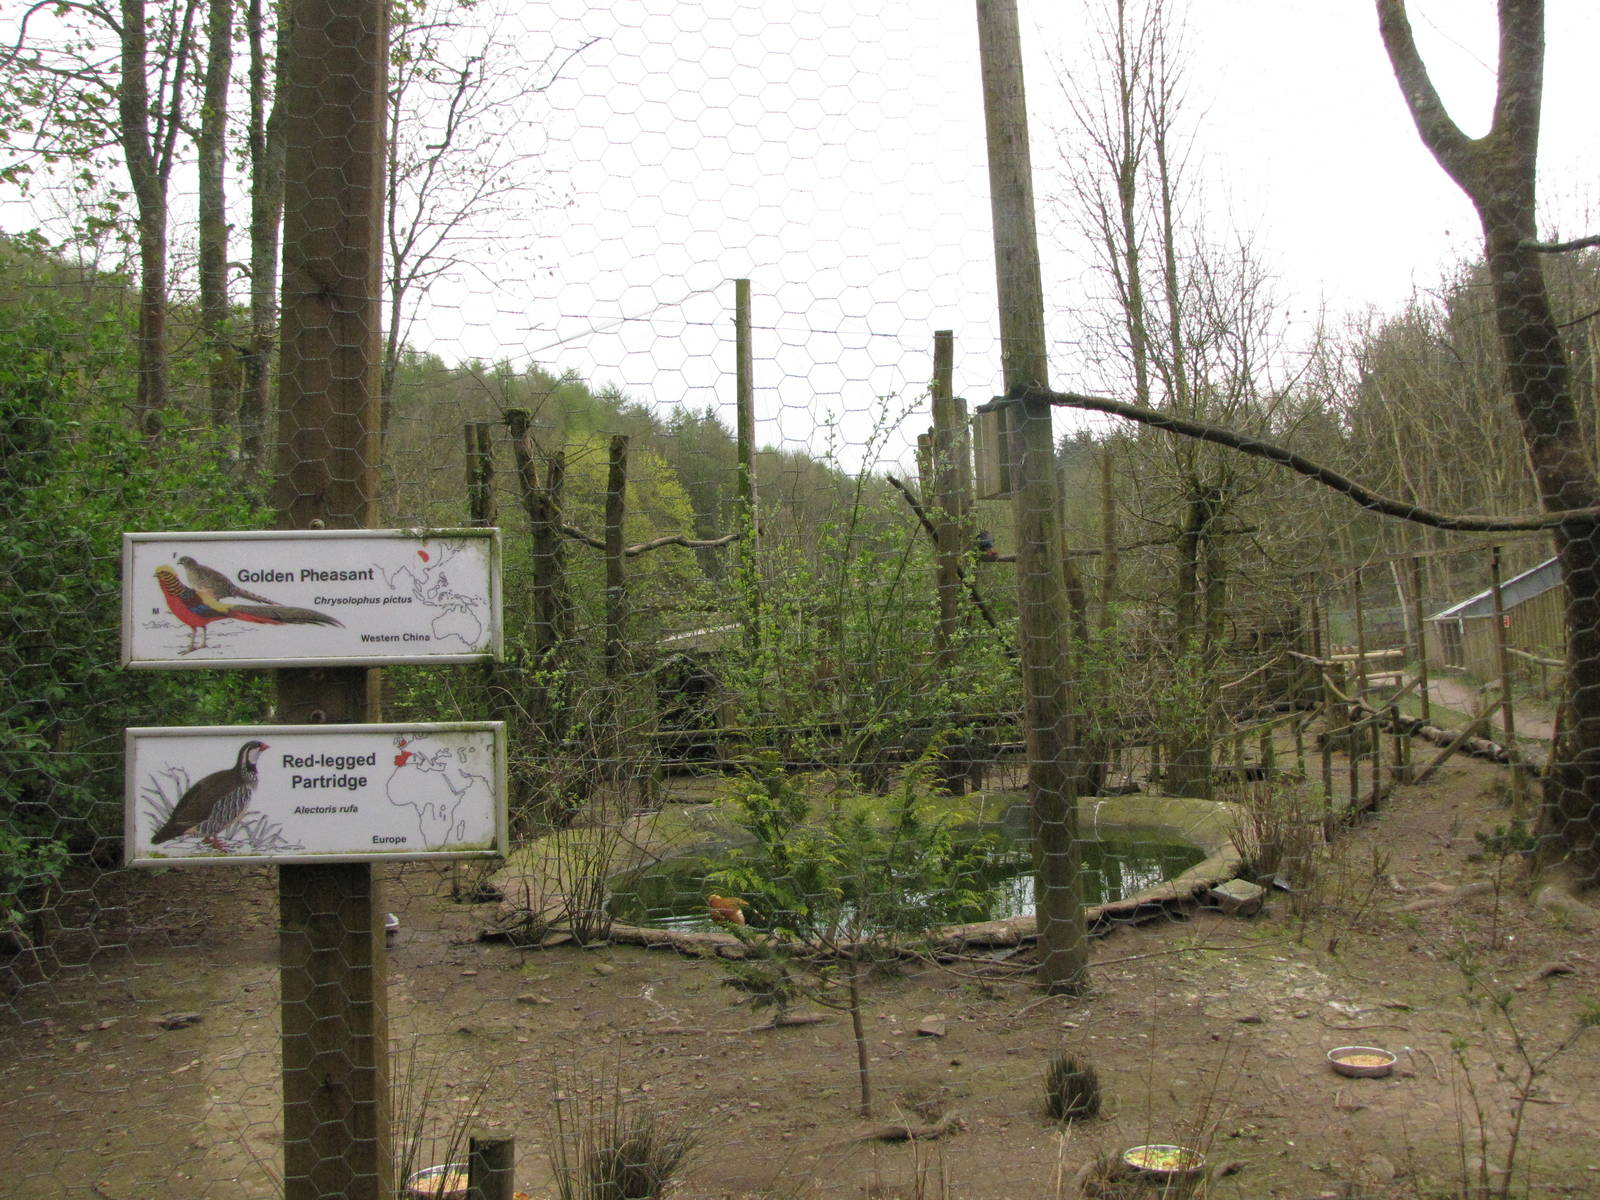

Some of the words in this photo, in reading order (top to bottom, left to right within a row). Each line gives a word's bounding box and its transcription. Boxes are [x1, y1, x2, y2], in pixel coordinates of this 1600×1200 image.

[237, 568, 294, 583] Golden
[300, 568, 375, 582] Pheasant
[313, 596, 381, 606] Chrysolophus
[382, 595, 413, 605] pictus
[152, 607, 160, 615] M
[360, 633, 400, 643] Western
[402, 632, 431, 642] China
[282, 752, 376, 770] Red-legged
[292, 774, 368, 790] Partridge
[294, 805, 337, 815] Alectoris
[339, 804, 359, 814] rufa
[372, 834, 407, 845] Europe
